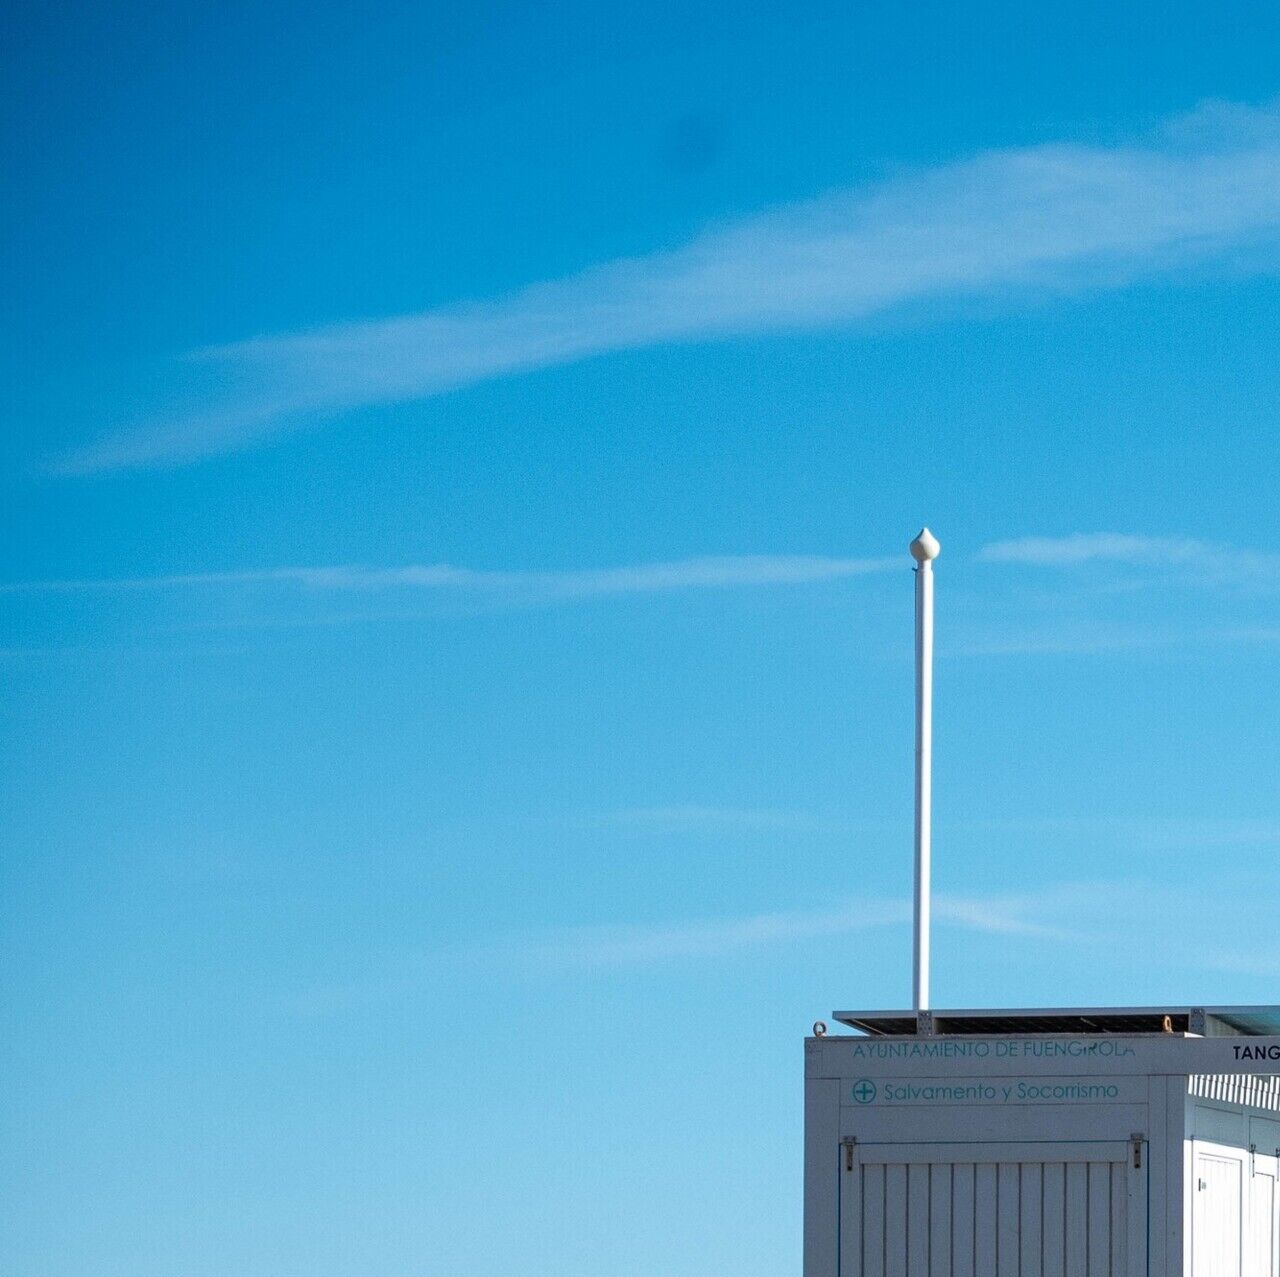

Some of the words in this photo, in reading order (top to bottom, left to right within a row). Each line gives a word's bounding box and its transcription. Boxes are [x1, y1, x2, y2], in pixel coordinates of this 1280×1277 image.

[853, 1042, 990, 1057] AYUNTAMIENTO
[996, 1041, 1018, 1056] DE
[884, 1084, 996, 1100] Salvamento
[1001, 1086, 1012, 1102] y
[1017, 1082, 1119, 1100] Socorrismo
